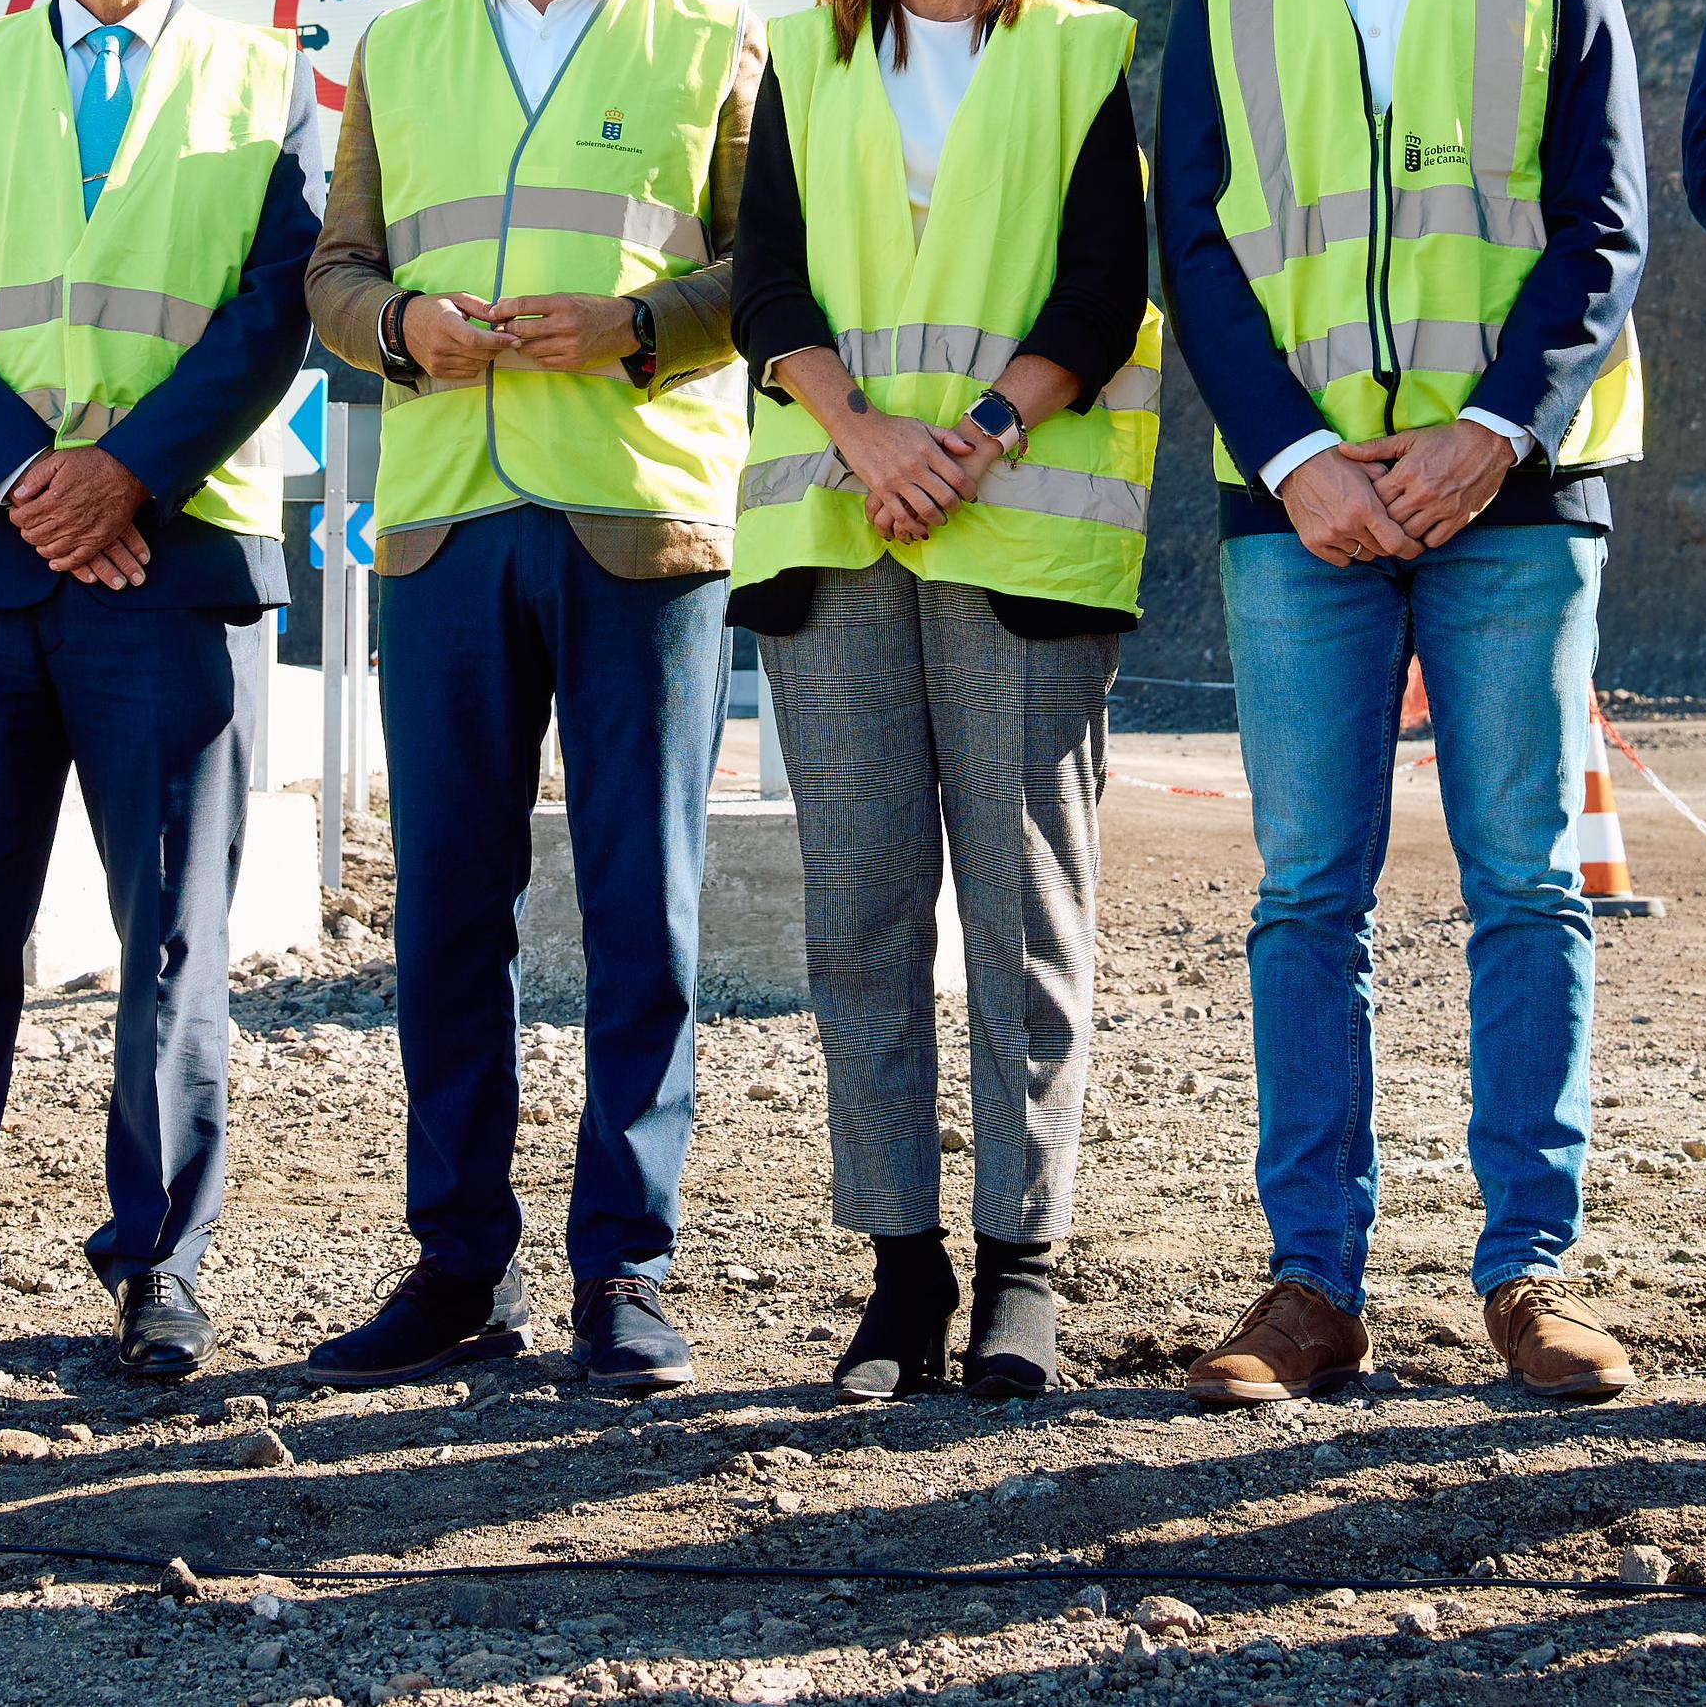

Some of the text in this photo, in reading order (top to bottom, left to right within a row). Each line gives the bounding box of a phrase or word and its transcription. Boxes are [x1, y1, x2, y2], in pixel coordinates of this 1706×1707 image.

[575, 140, 643, 155] Gobierno de Canarias
[1423, 156, 1435, 167] de
